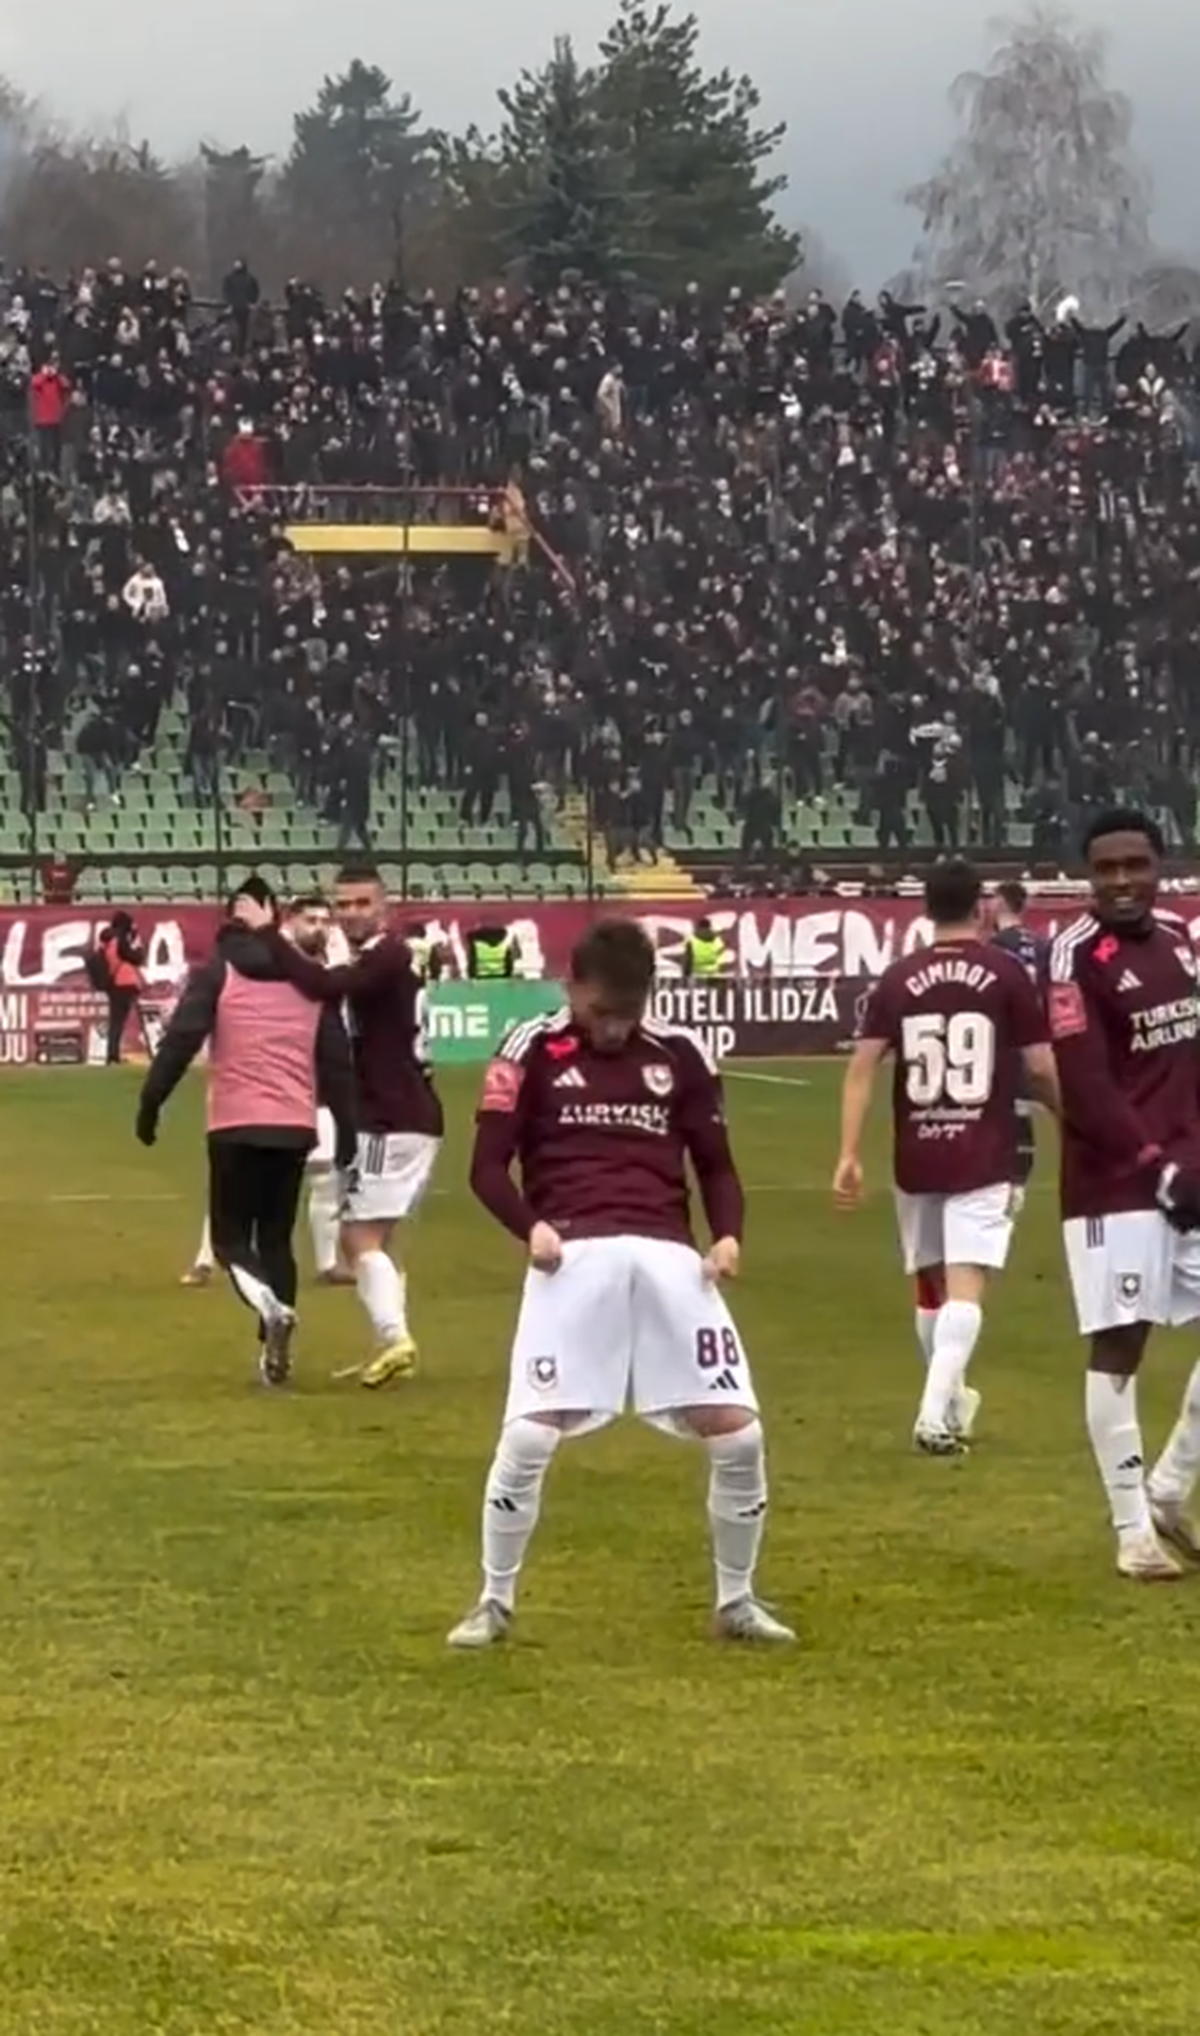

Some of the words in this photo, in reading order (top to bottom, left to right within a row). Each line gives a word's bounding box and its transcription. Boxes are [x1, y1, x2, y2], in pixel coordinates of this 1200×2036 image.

[744, 979, 839, 1021] ILIDŽA
[902, 1012, 995, 1105] 59
[696, 1328, 739, 1369] 88
